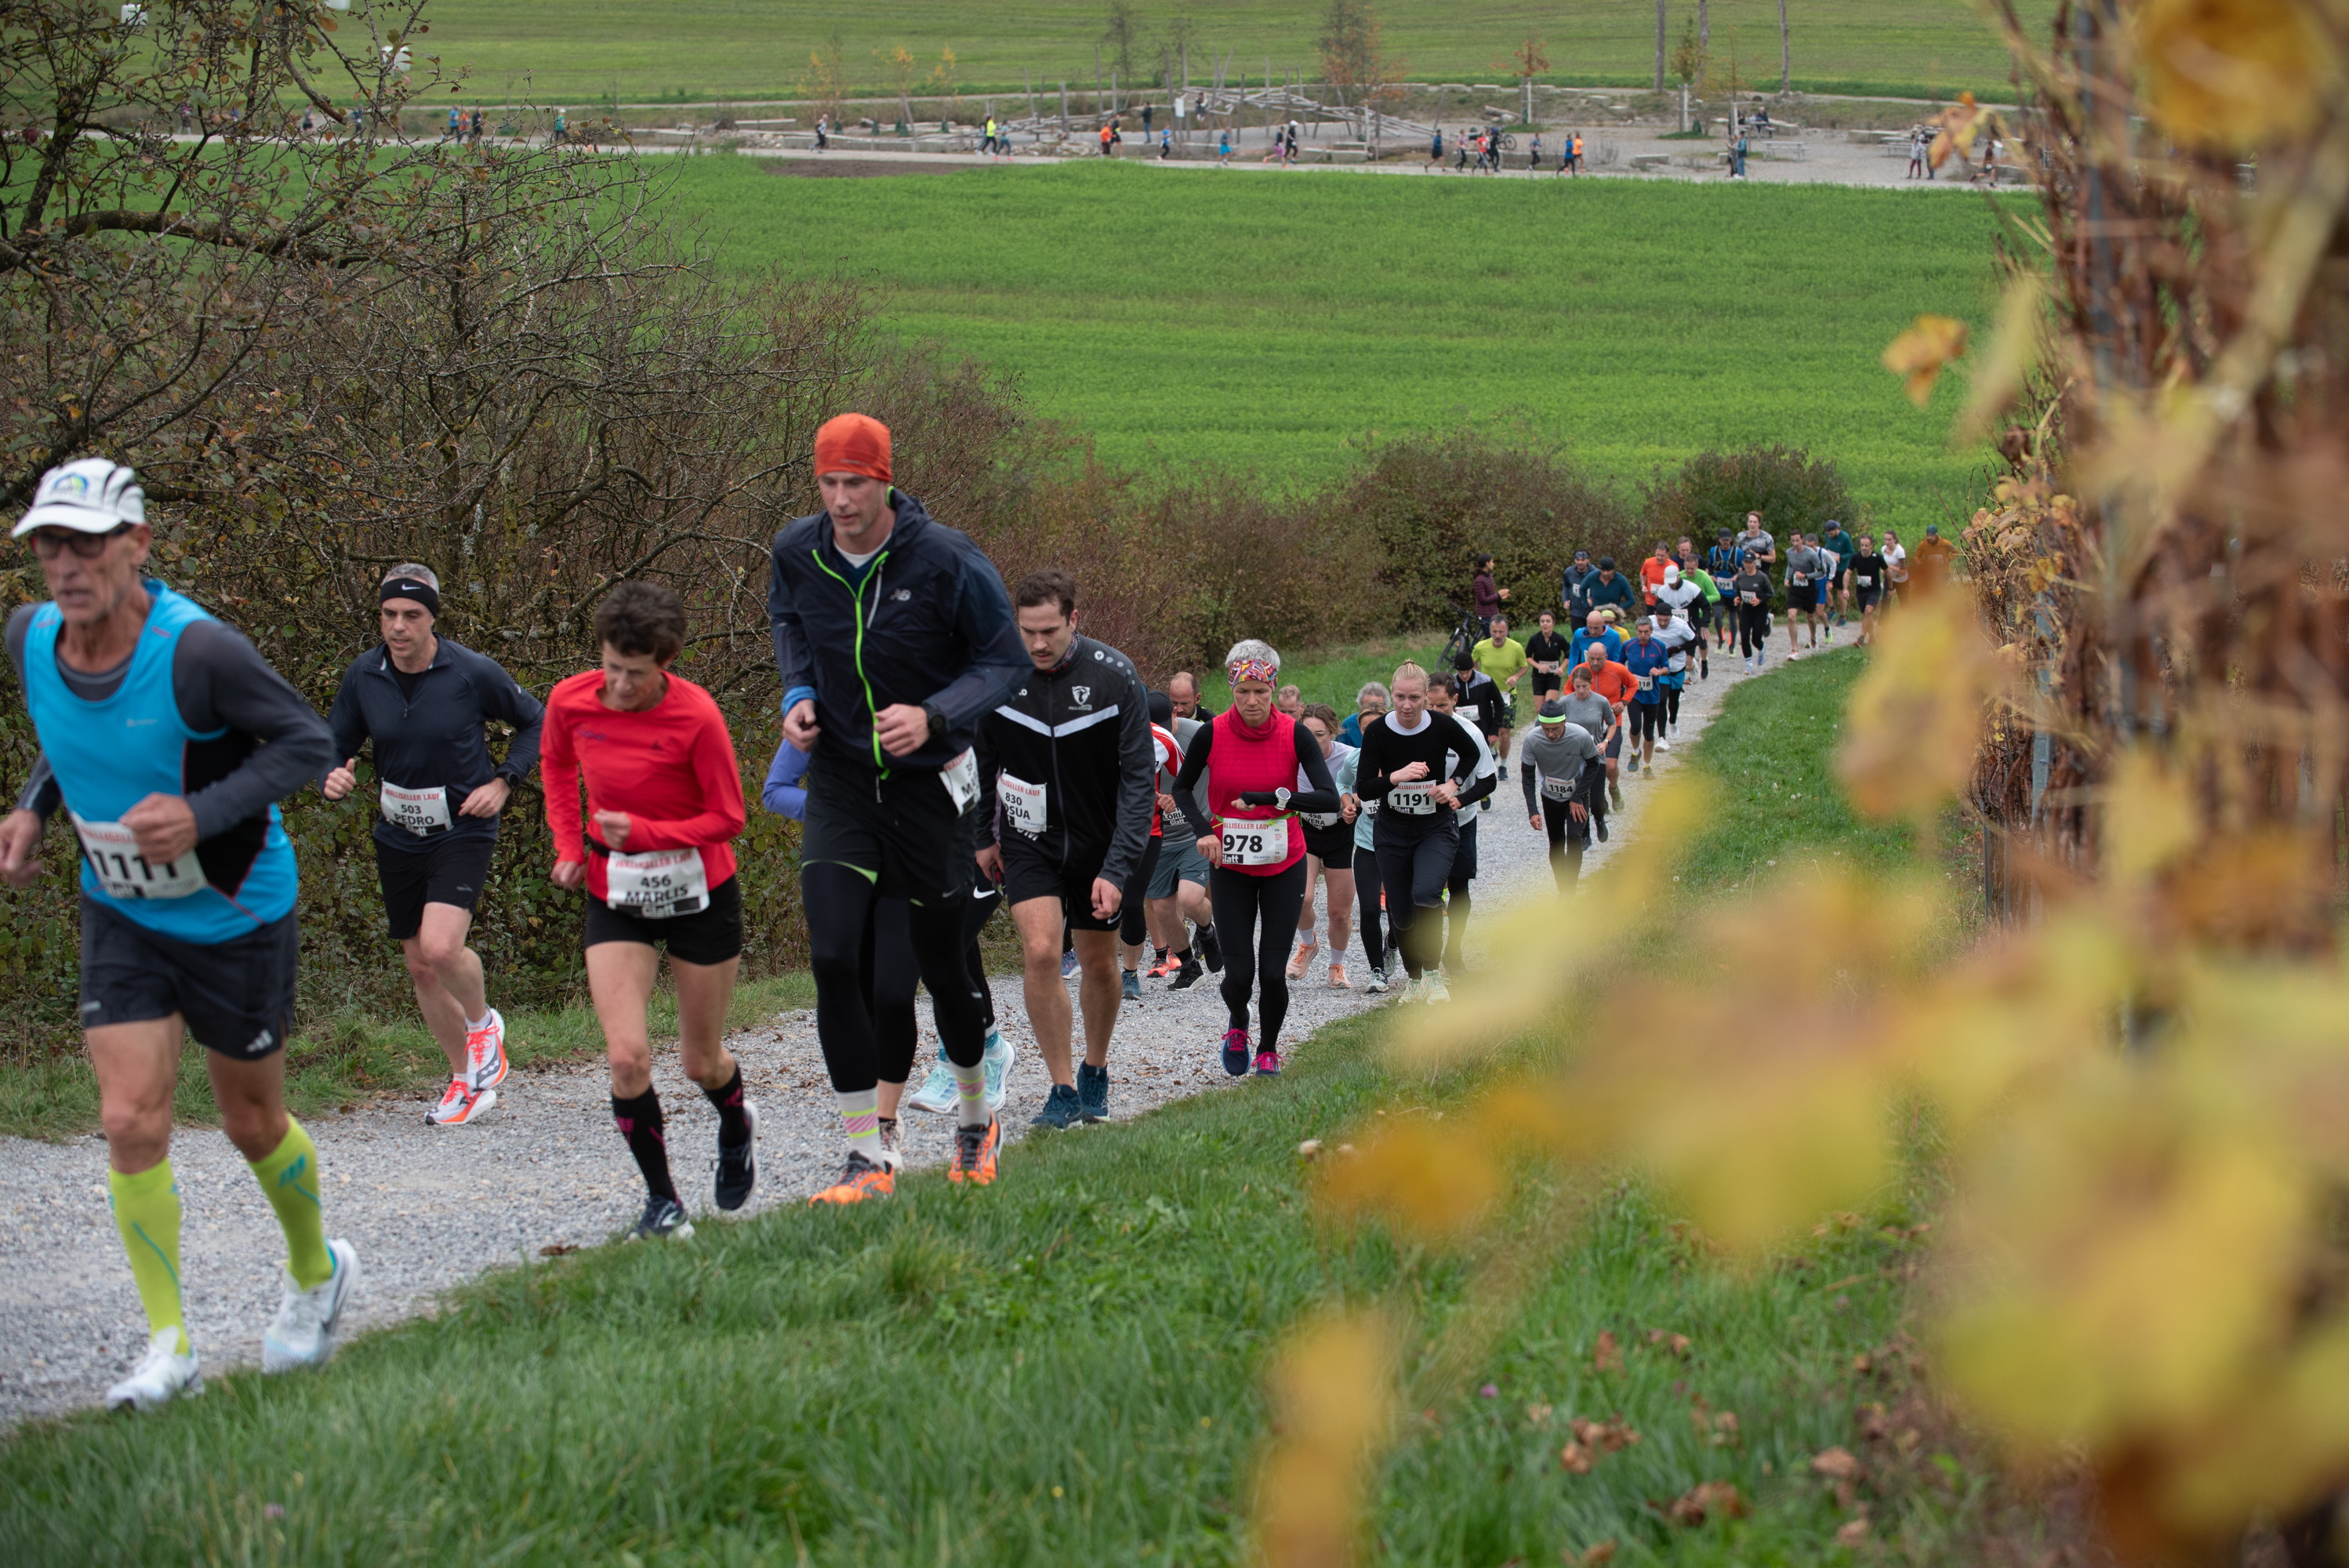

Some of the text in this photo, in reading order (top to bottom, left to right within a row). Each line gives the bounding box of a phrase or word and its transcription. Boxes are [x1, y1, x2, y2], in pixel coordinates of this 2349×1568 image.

[1005, 792, 1022, 806] 830
[1394, 793, 1430, 806] 1191
[401, 804, 422, 814] 503
[394, 813, 434, 825] PEDRO
[1224, 834, 1262, 853] 978
[641, 874, 671, 888] 456
[625, 884, 688, 902] MARLIS
